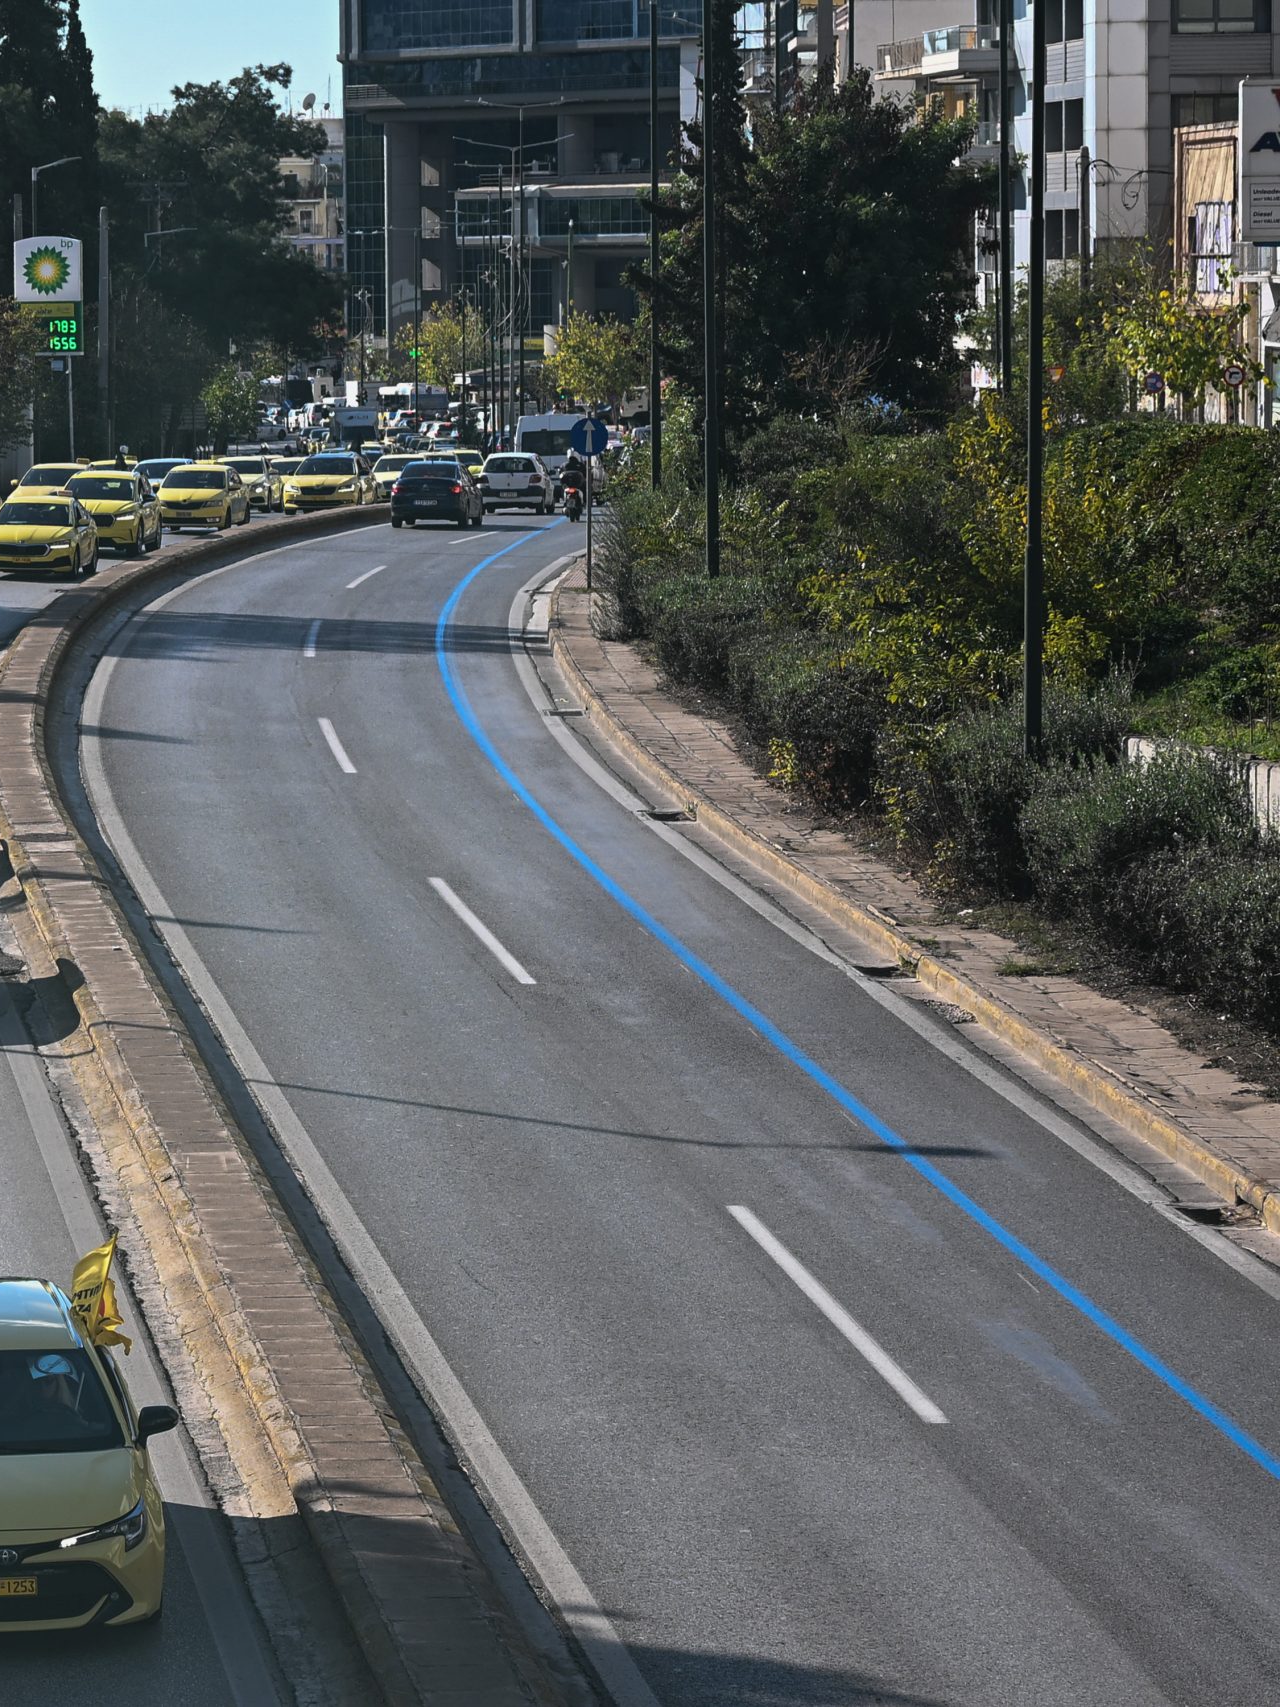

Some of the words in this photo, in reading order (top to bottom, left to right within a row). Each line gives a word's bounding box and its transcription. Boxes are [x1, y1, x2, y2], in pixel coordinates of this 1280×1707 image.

[60, 239, 73, 250] bp
[49, 320, 77, 333] 1783
[49, 336, 77, 350] 1556
